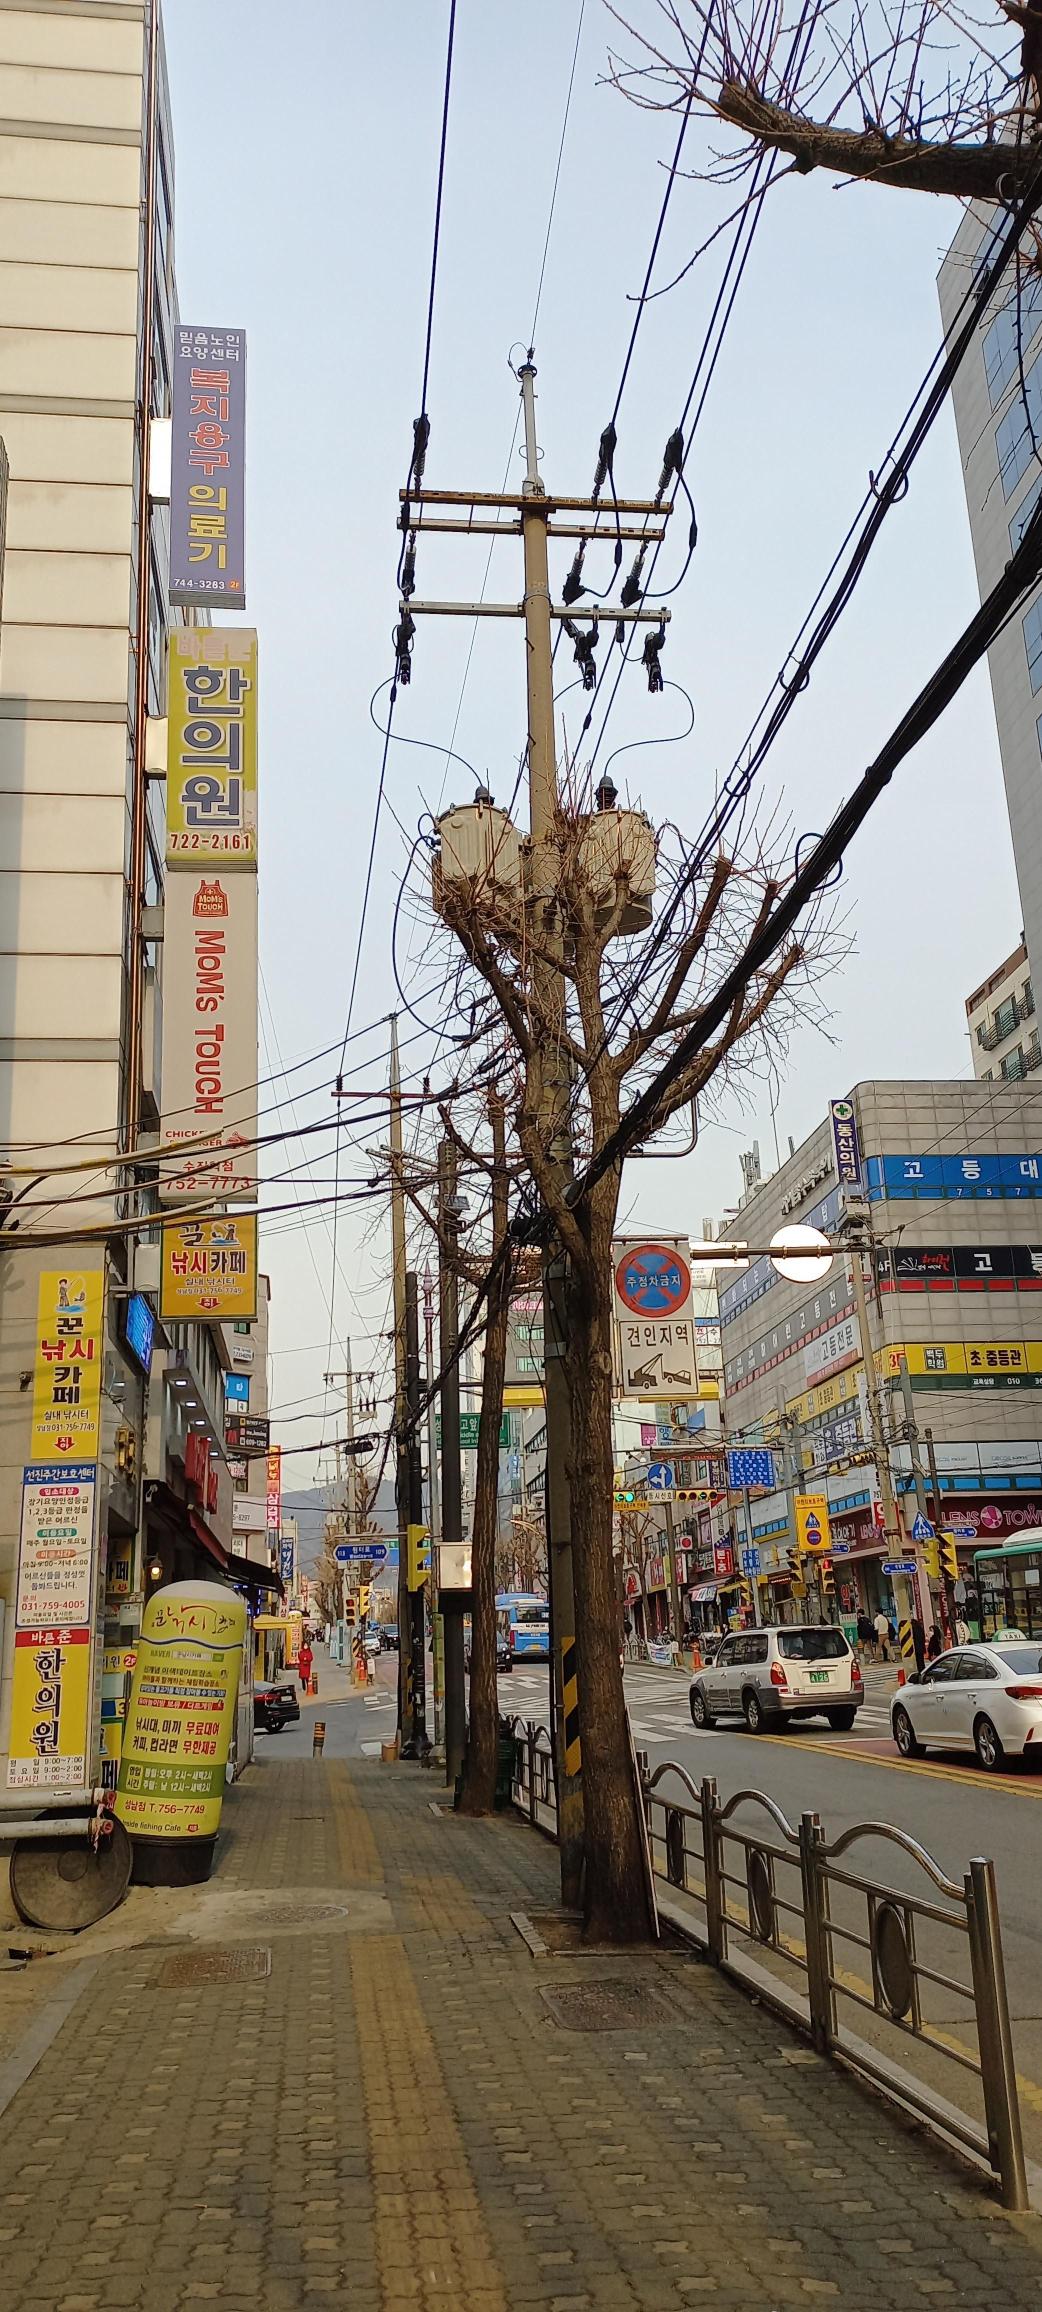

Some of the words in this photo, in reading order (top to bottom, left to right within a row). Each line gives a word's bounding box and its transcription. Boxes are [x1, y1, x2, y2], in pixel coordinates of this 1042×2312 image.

[179, 331, 240, 348] 믿음노인
[179, 346, 240, 362] 요양센터
[189, 367, 230, 475] 복지용구
[187, 485, 228, 569] 의료기
[173, 578, 225, 589] 744-3283
[181, 665, 250, 828] 한의원
[170, 833, 251, 850] 722-2161
[197, 902, 224, 912] TOUCH
[194, 1024, 225, 1114] TOUCH
[836, 1123, 857, 1181] 동산의원
[171, 1250, 247, 1275] 낚시카페
[626, 1274, 681, 1288] 주정차금지
[56, 1317, 84, 1335] 꾼
[627, 1324, 689, 1347] 견인지역
[41, 1338, 95, 1361] 낚시
[52, 1366, 82, 1404] 카페
[44, 1411, 61, 1420] 실내
[63, 1410, 89, 1419] 낚시터
[26, 1467, 95, 1482] 선진주간보호센터
[267, 1493, 280, 1528] 삼겹살
[1003, 1505, 1042, 1526] TOW
[21, 1600, 85, 1611] 031-759-4005
[31, 1630, 73, 1644] 바른준
[125, 1656, 137, 1667] 2F
[29, 1648, 66, 1757] 한의원
[136, 1717, 161, 1735] 낚시대,
[162, 1719, 181, 1734] 미끼
[185, 1721, 220, 1736] 무료대여
[182, 1740, 217, 1755] 무한제공
[9, 1775, 39, 1784] 점심시간
[127, 1778, 141, 1789] 시간
[125, 1799, 146, 1812] 성남점
[164, 1824, 182, 1832] Cafe
